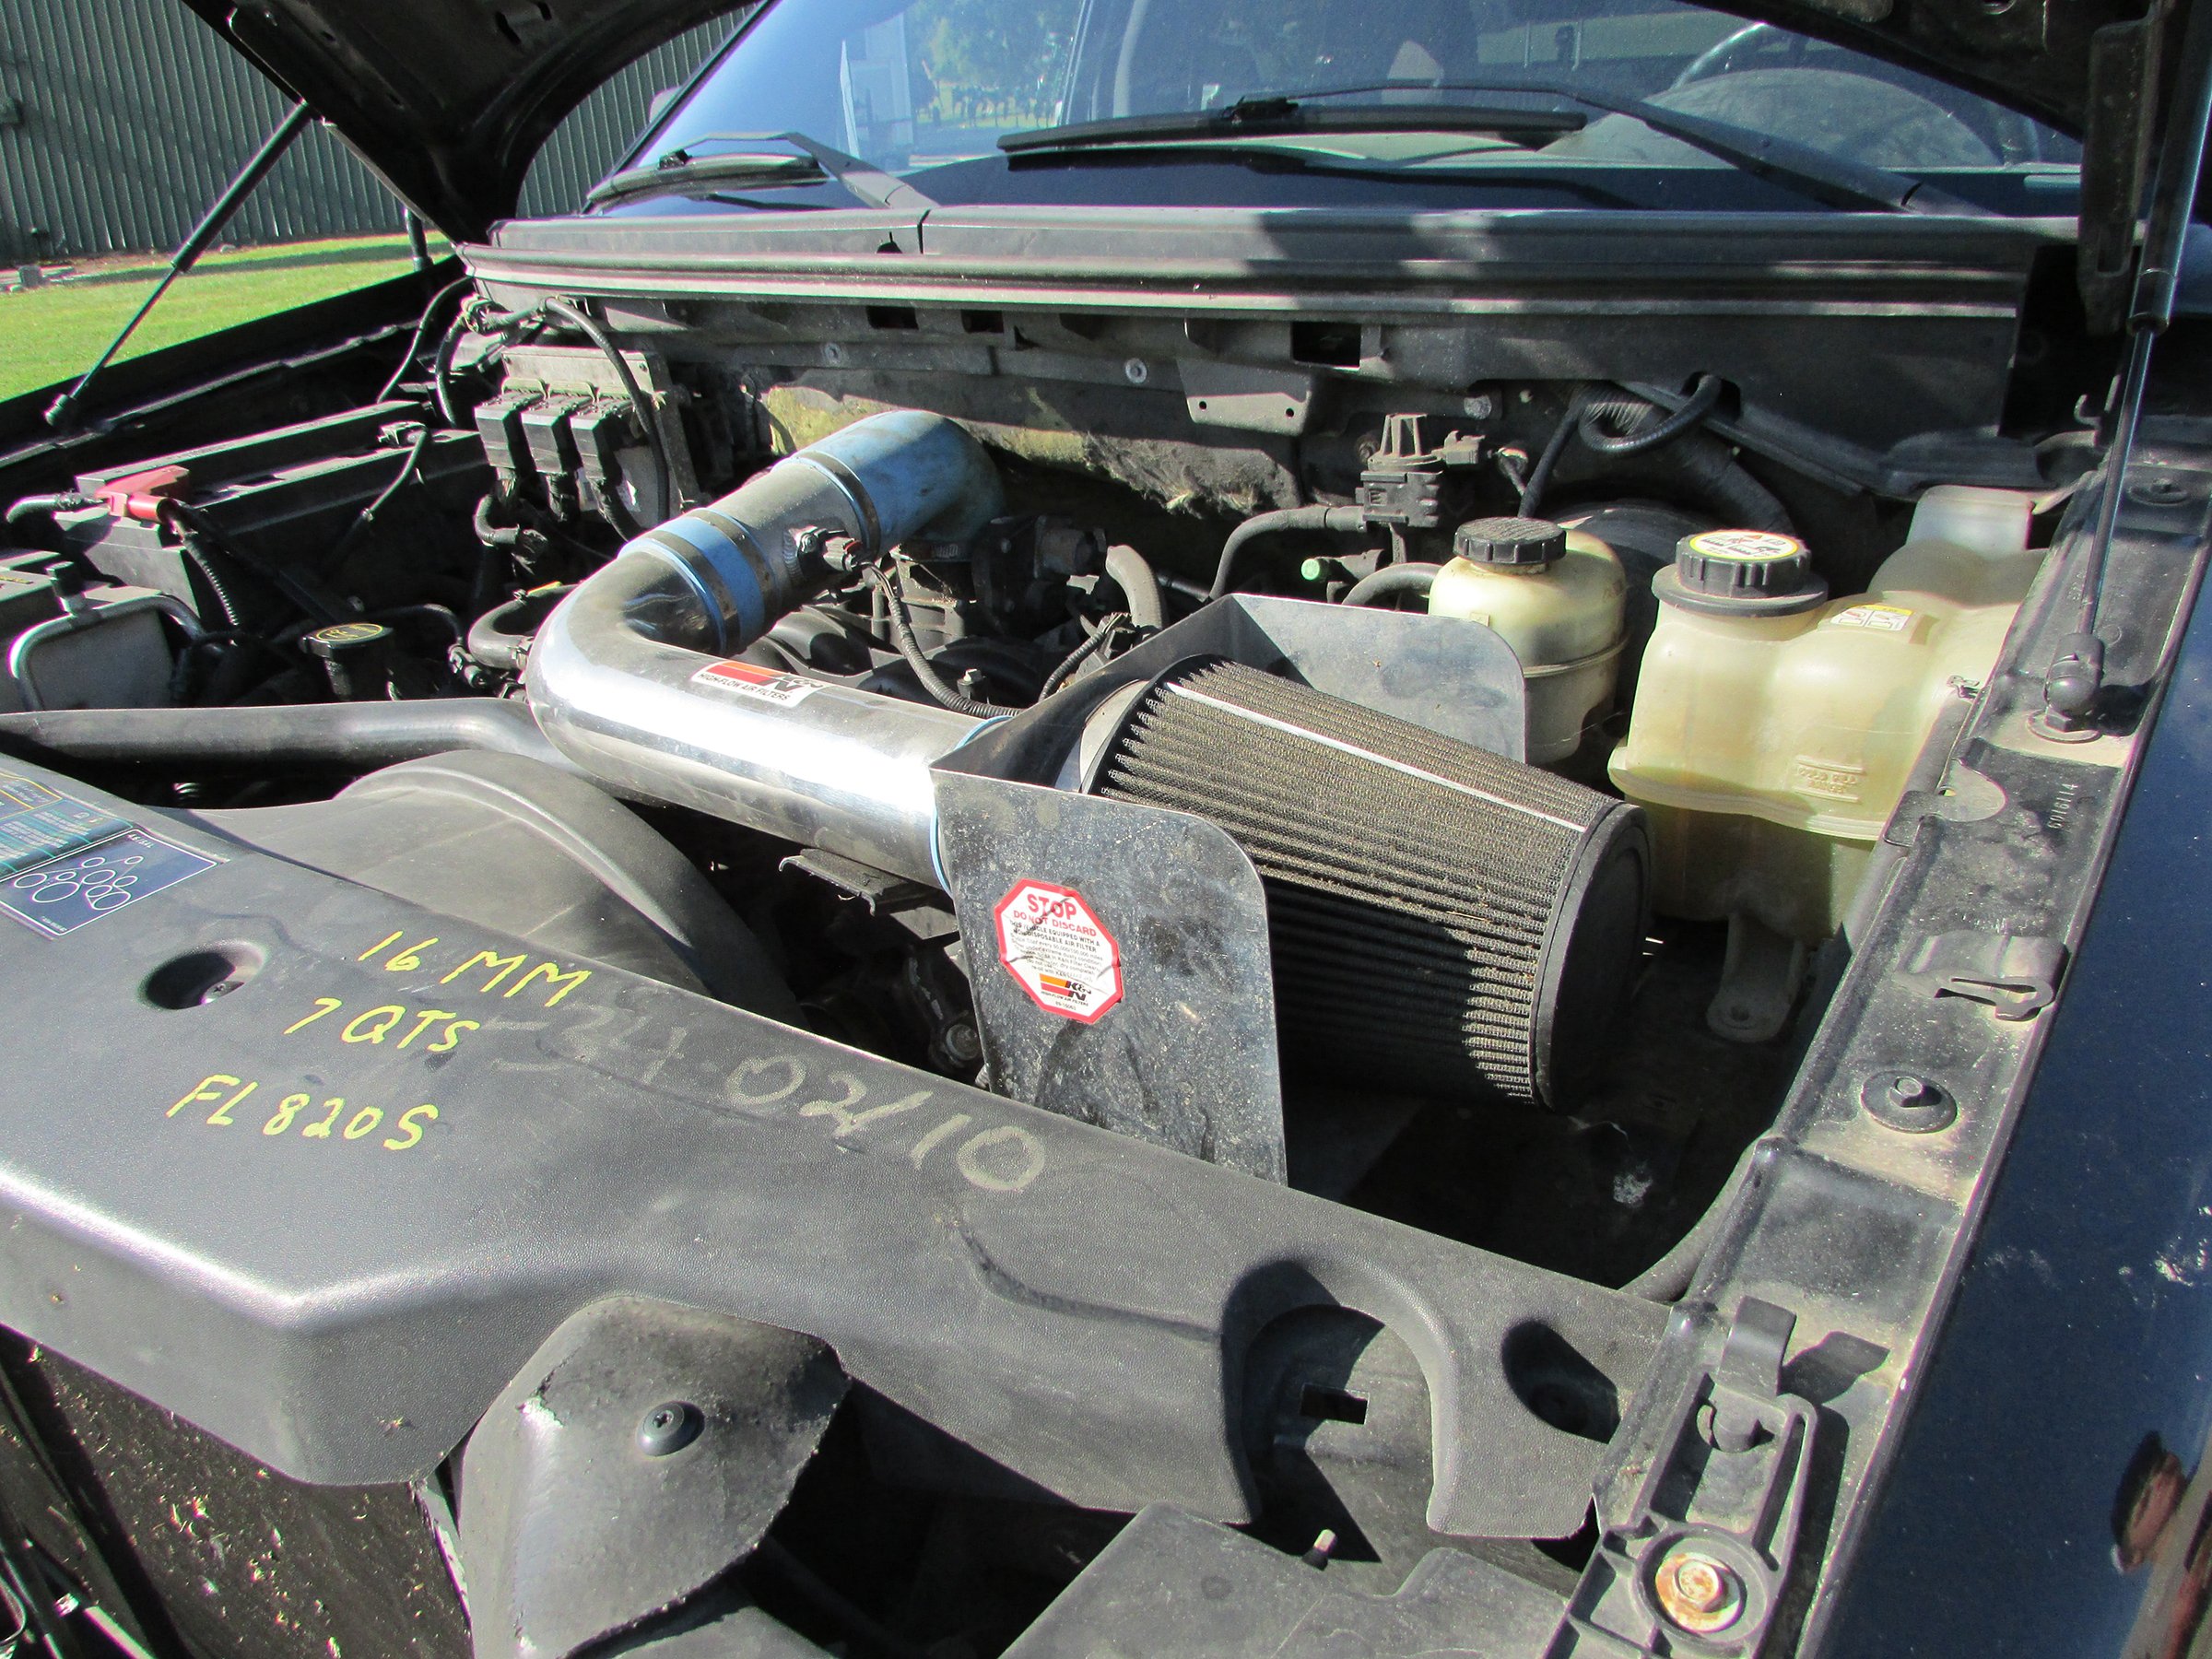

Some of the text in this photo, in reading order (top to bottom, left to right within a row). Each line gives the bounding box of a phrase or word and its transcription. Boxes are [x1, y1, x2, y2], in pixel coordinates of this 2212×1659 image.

[698, 673, 742, 688] HIGH-FLOW
[756, 687, 792, 700] FILTERS
[1027, 893, 1077, 920] STOP
[1014, 910, 1097, 936] DO NOT DISCARD
[1049, 928, 1078, 940] EQUIPPED
[1079, 935, 1095, 946] WITH
[1065, 940, 1076, 948] AIR
[1076, 943, 1097, 953] FILTER
[358, 930, 593, 1008] 16 MM
[1065, 981, 1092, 1001] K&N
[283, 997, 343, 1035] 7
[341, 1005, 481, 1053] QTS
